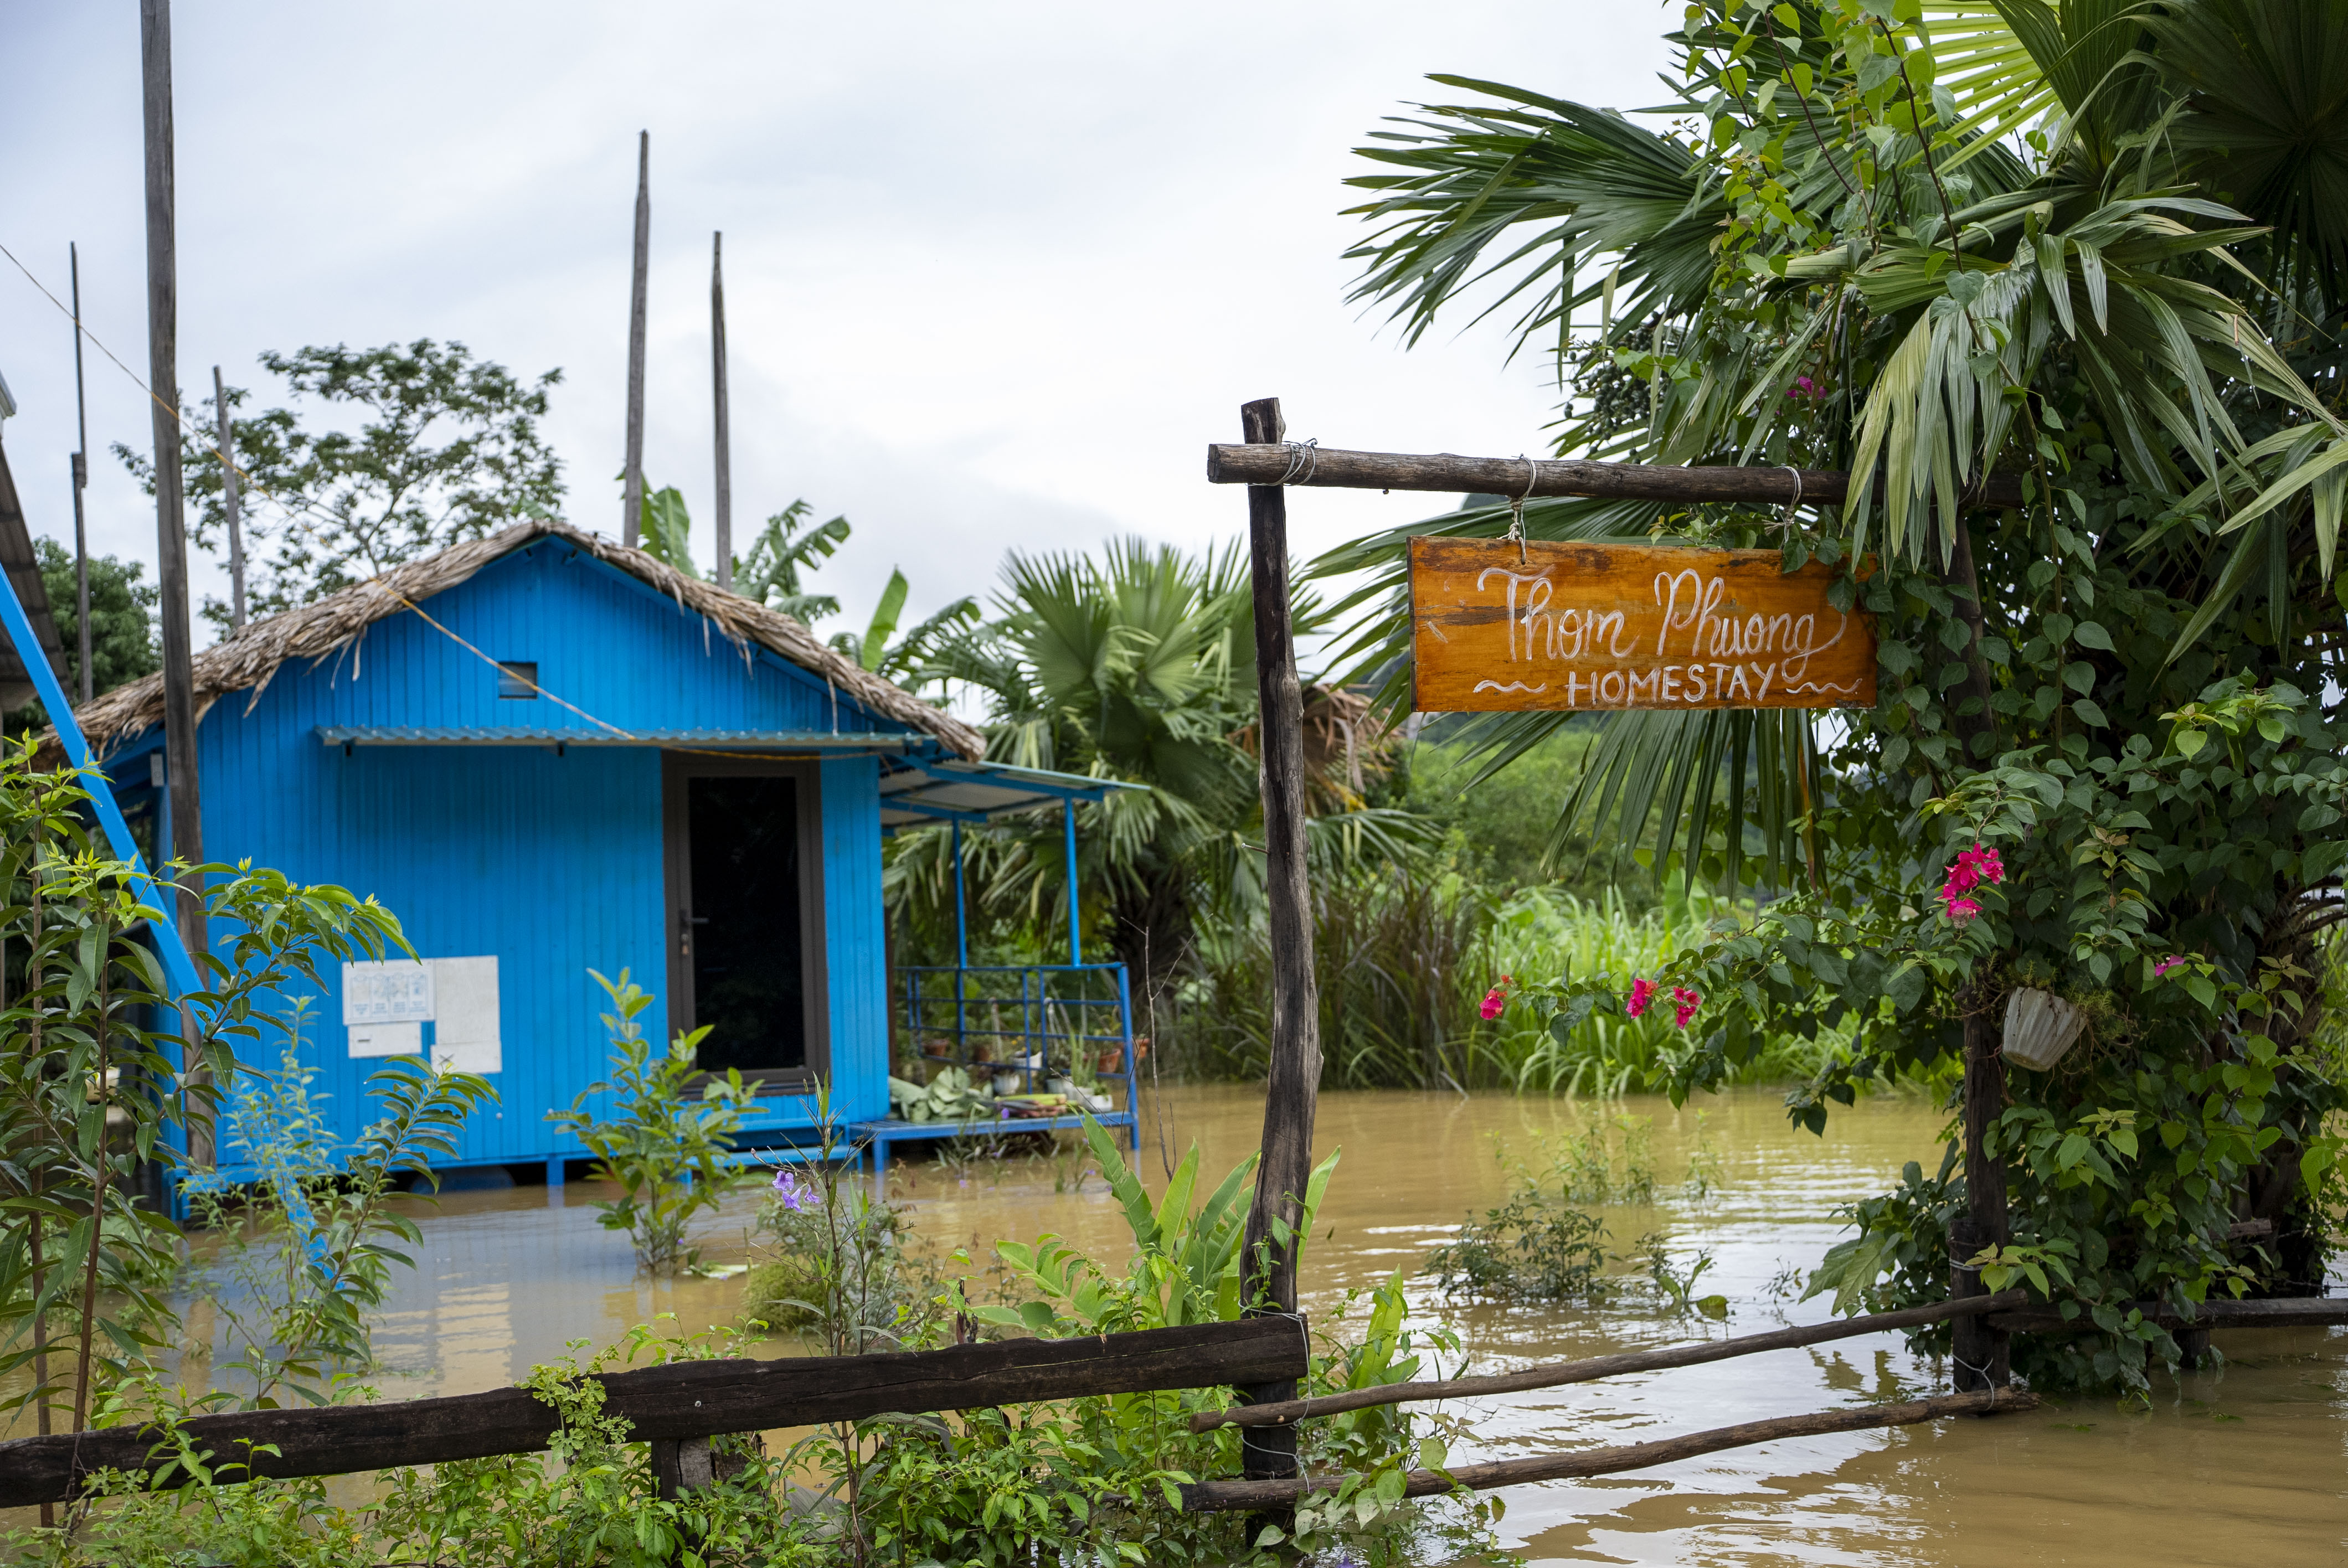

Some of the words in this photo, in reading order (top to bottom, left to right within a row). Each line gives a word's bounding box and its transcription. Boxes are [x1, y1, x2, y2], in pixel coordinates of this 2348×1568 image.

[1477, 564, 1640, 663] Thom
[1654, 568, 1847, 684] Phuong
[1564, 661, 1777, 707] HOMESTAY
